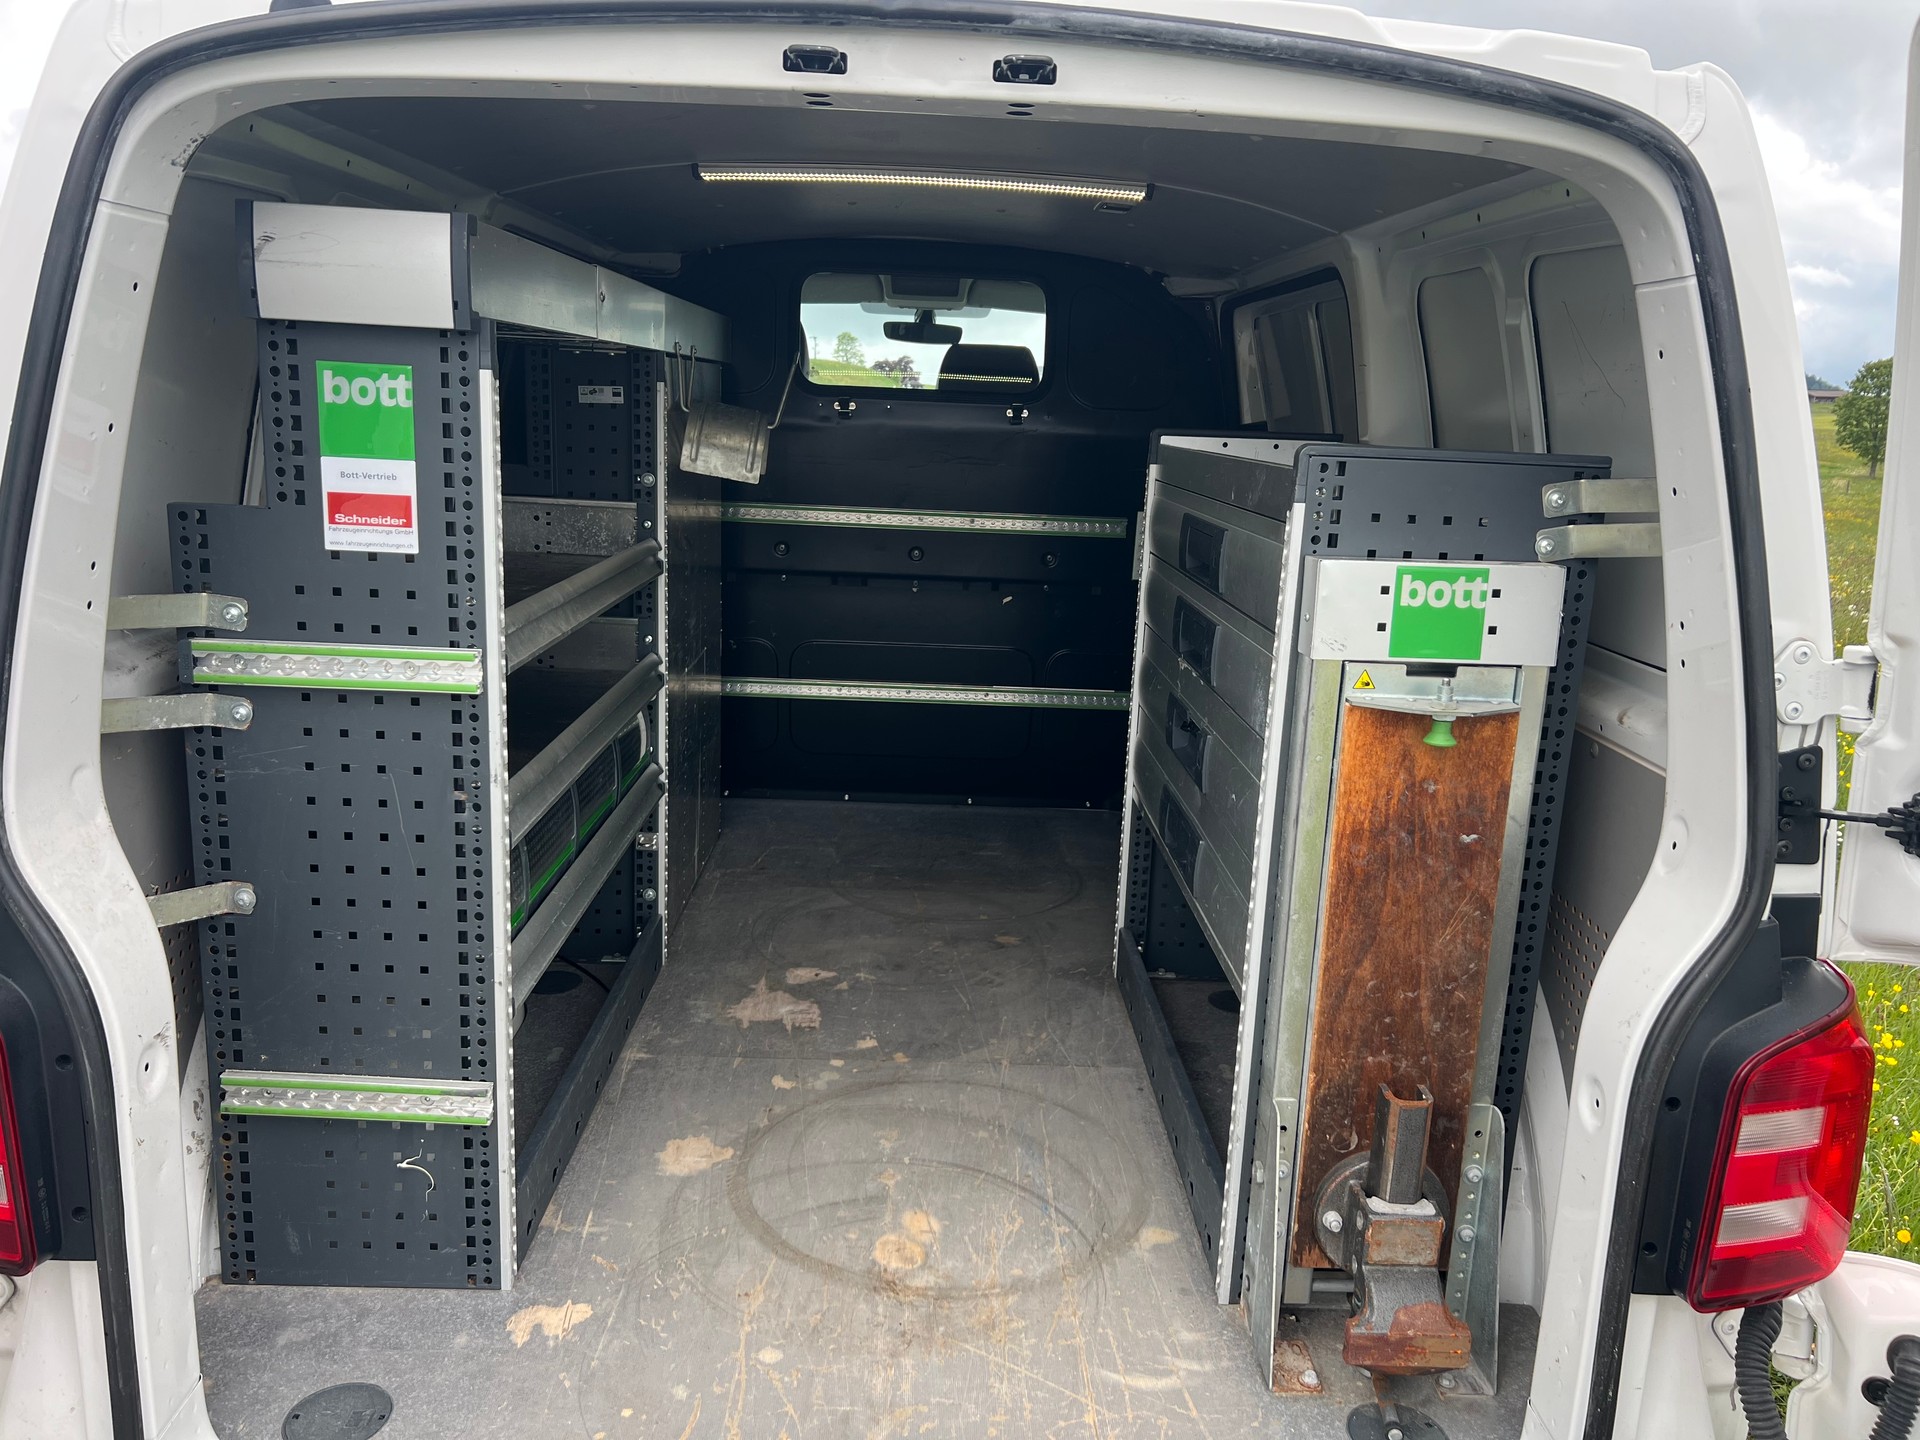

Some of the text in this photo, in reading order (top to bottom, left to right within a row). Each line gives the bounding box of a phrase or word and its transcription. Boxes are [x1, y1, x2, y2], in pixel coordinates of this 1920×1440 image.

[323, 370, 412, 407] bott
[340, 471, 397, 481] Bott-Vertrieb
[334, 513, 406, 526] Schneider
[328, 526, 393, 535] Fahrzeugeinrichtungs
[1400, 575, 1487, 608] bott
